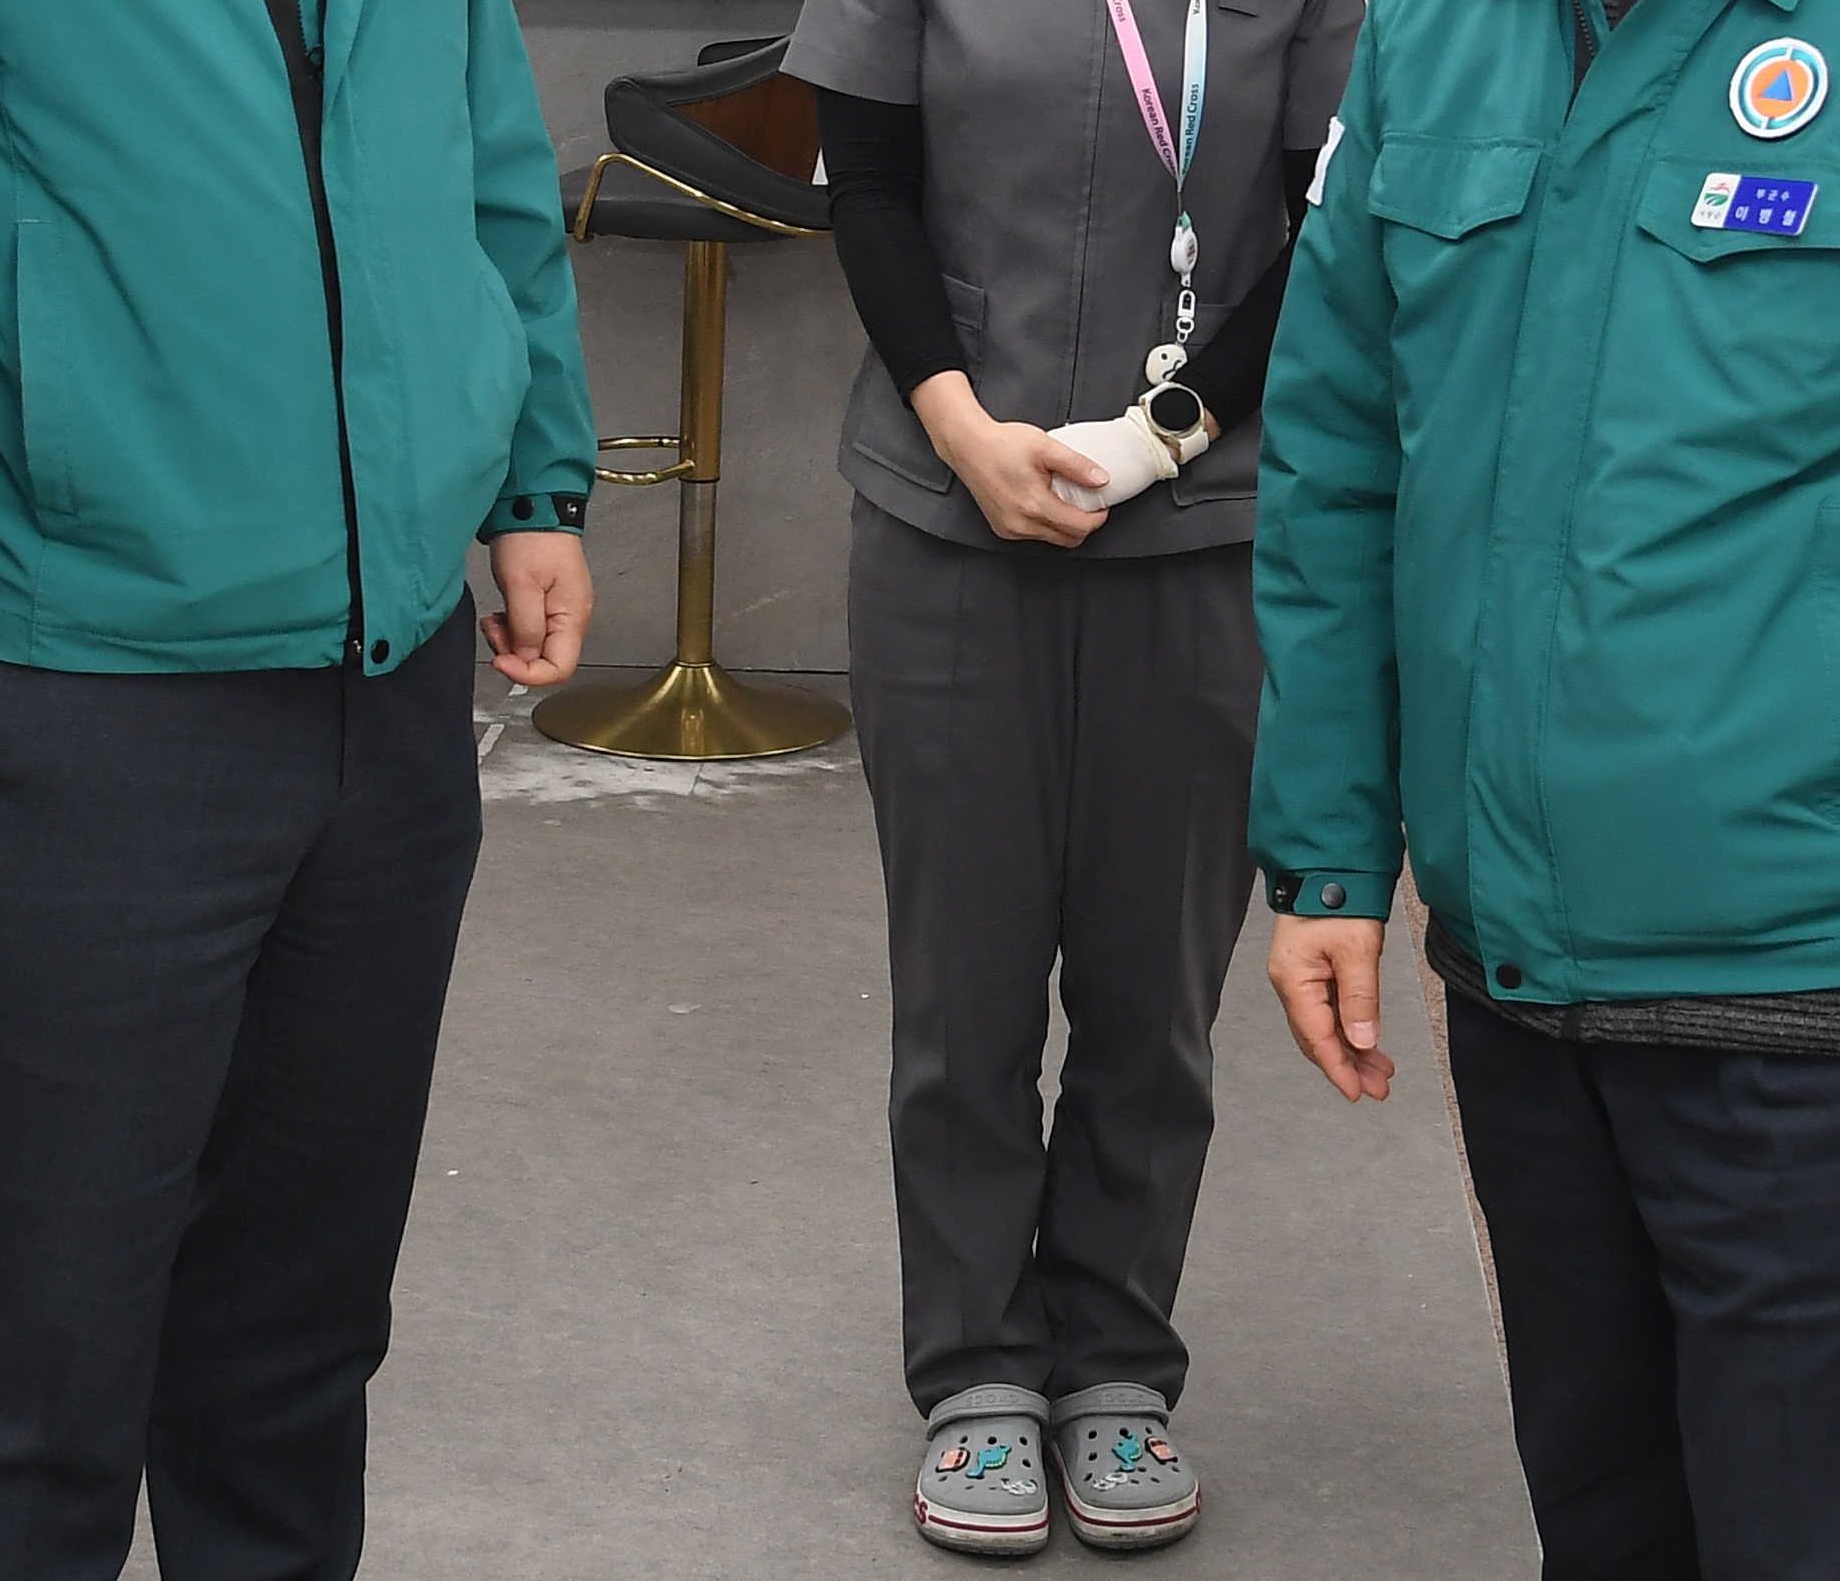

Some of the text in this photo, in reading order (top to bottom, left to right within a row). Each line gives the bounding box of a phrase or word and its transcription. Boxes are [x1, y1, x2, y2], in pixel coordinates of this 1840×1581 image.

[1187, 83, 1200, 113] Cross
[1141, 88, 1159, 127] Korean
[1155, 126, 1168, 148] Red
[1186, 113, 1195, 137] Red
